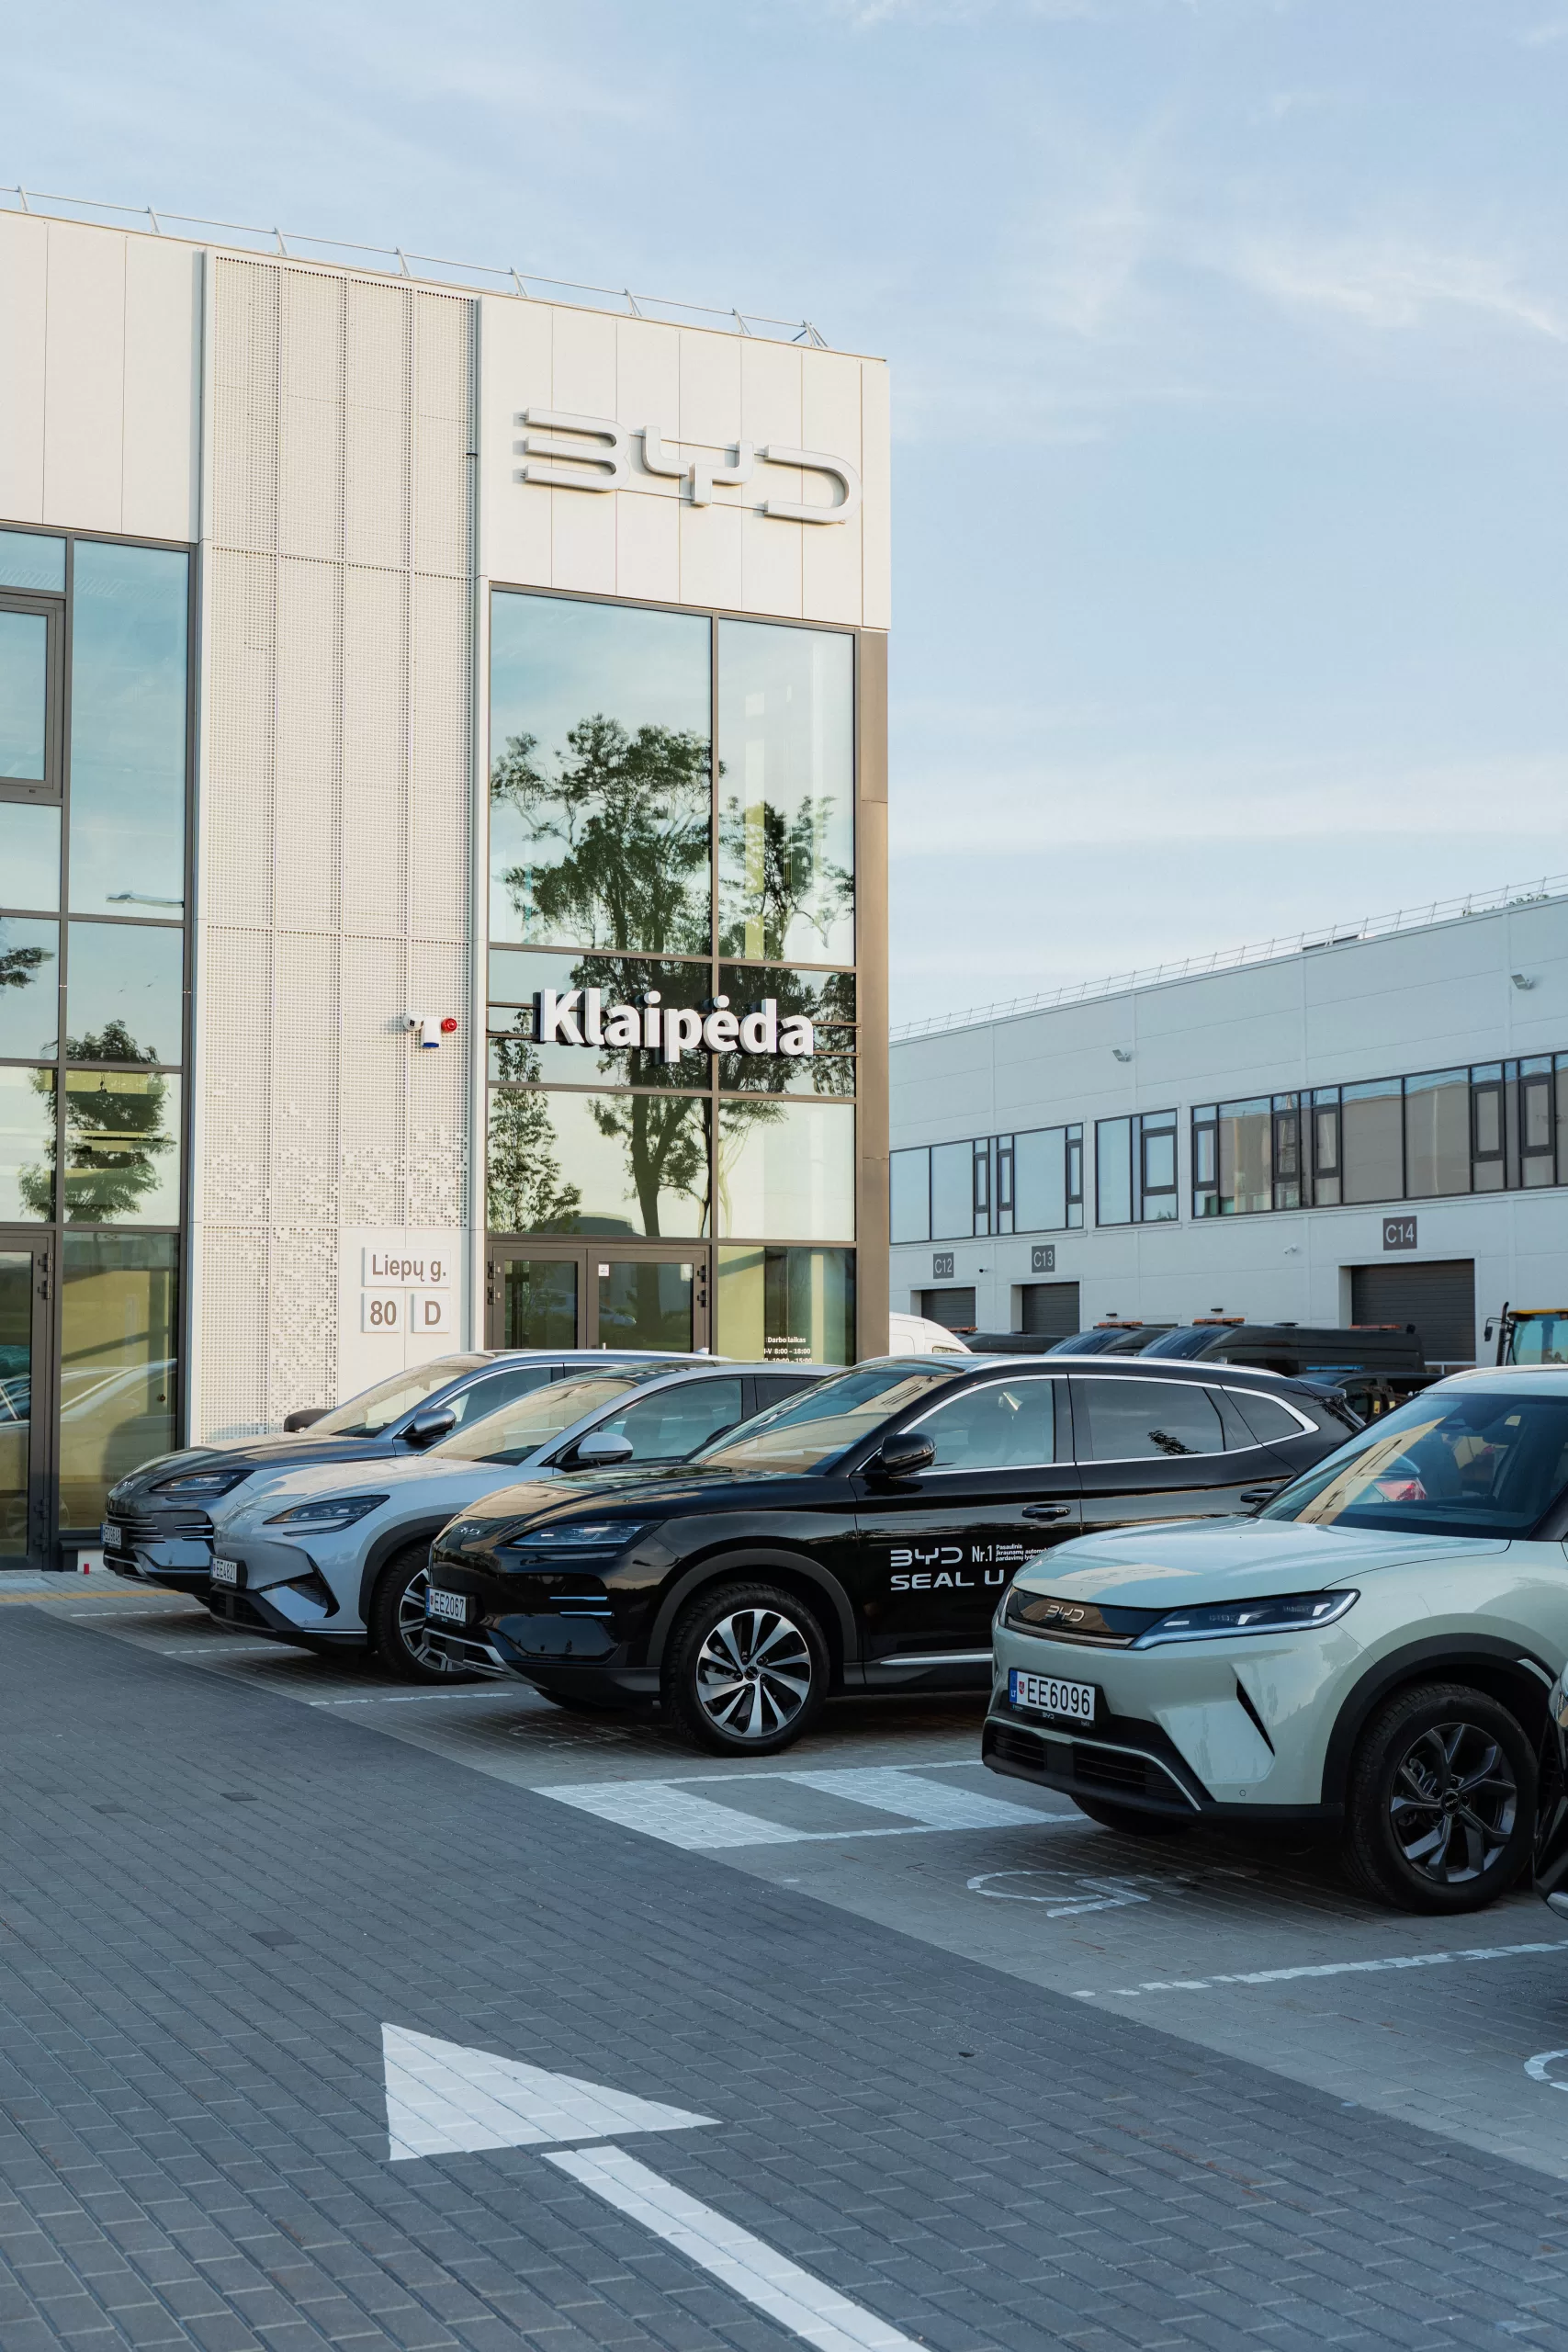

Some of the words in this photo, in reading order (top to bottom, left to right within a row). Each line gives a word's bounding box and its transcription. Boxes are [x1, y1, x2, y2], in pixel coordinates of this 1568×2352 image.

[524, 407, 863, 525] BYD
[539, 987, 815, 1063] Klaipėda
[1385, 1223, 1415, 1244] C14
[372, 1254, 425, 1283] Liepų
[430, 1260, 446, 1283] g.
[934, 1258, 953, 1274] C12
[1033, 1250, 1054, 1268] C13
[369, 1300, 397, 1326] 80
[424, 1300, 441, 1326] D
[890, 1546, 964, 1567] BYD
[972, 1544, 993, 1563] Nr.1
[890, 1571, 975, 1590] SEAL
[984, 1569, 1005, 1585] U
[434, 1591, 464, 1619] EE2067
[1044, 1604, 1085, 1623] BYD
[1027, 1677, 1090, 1716] EE6096
